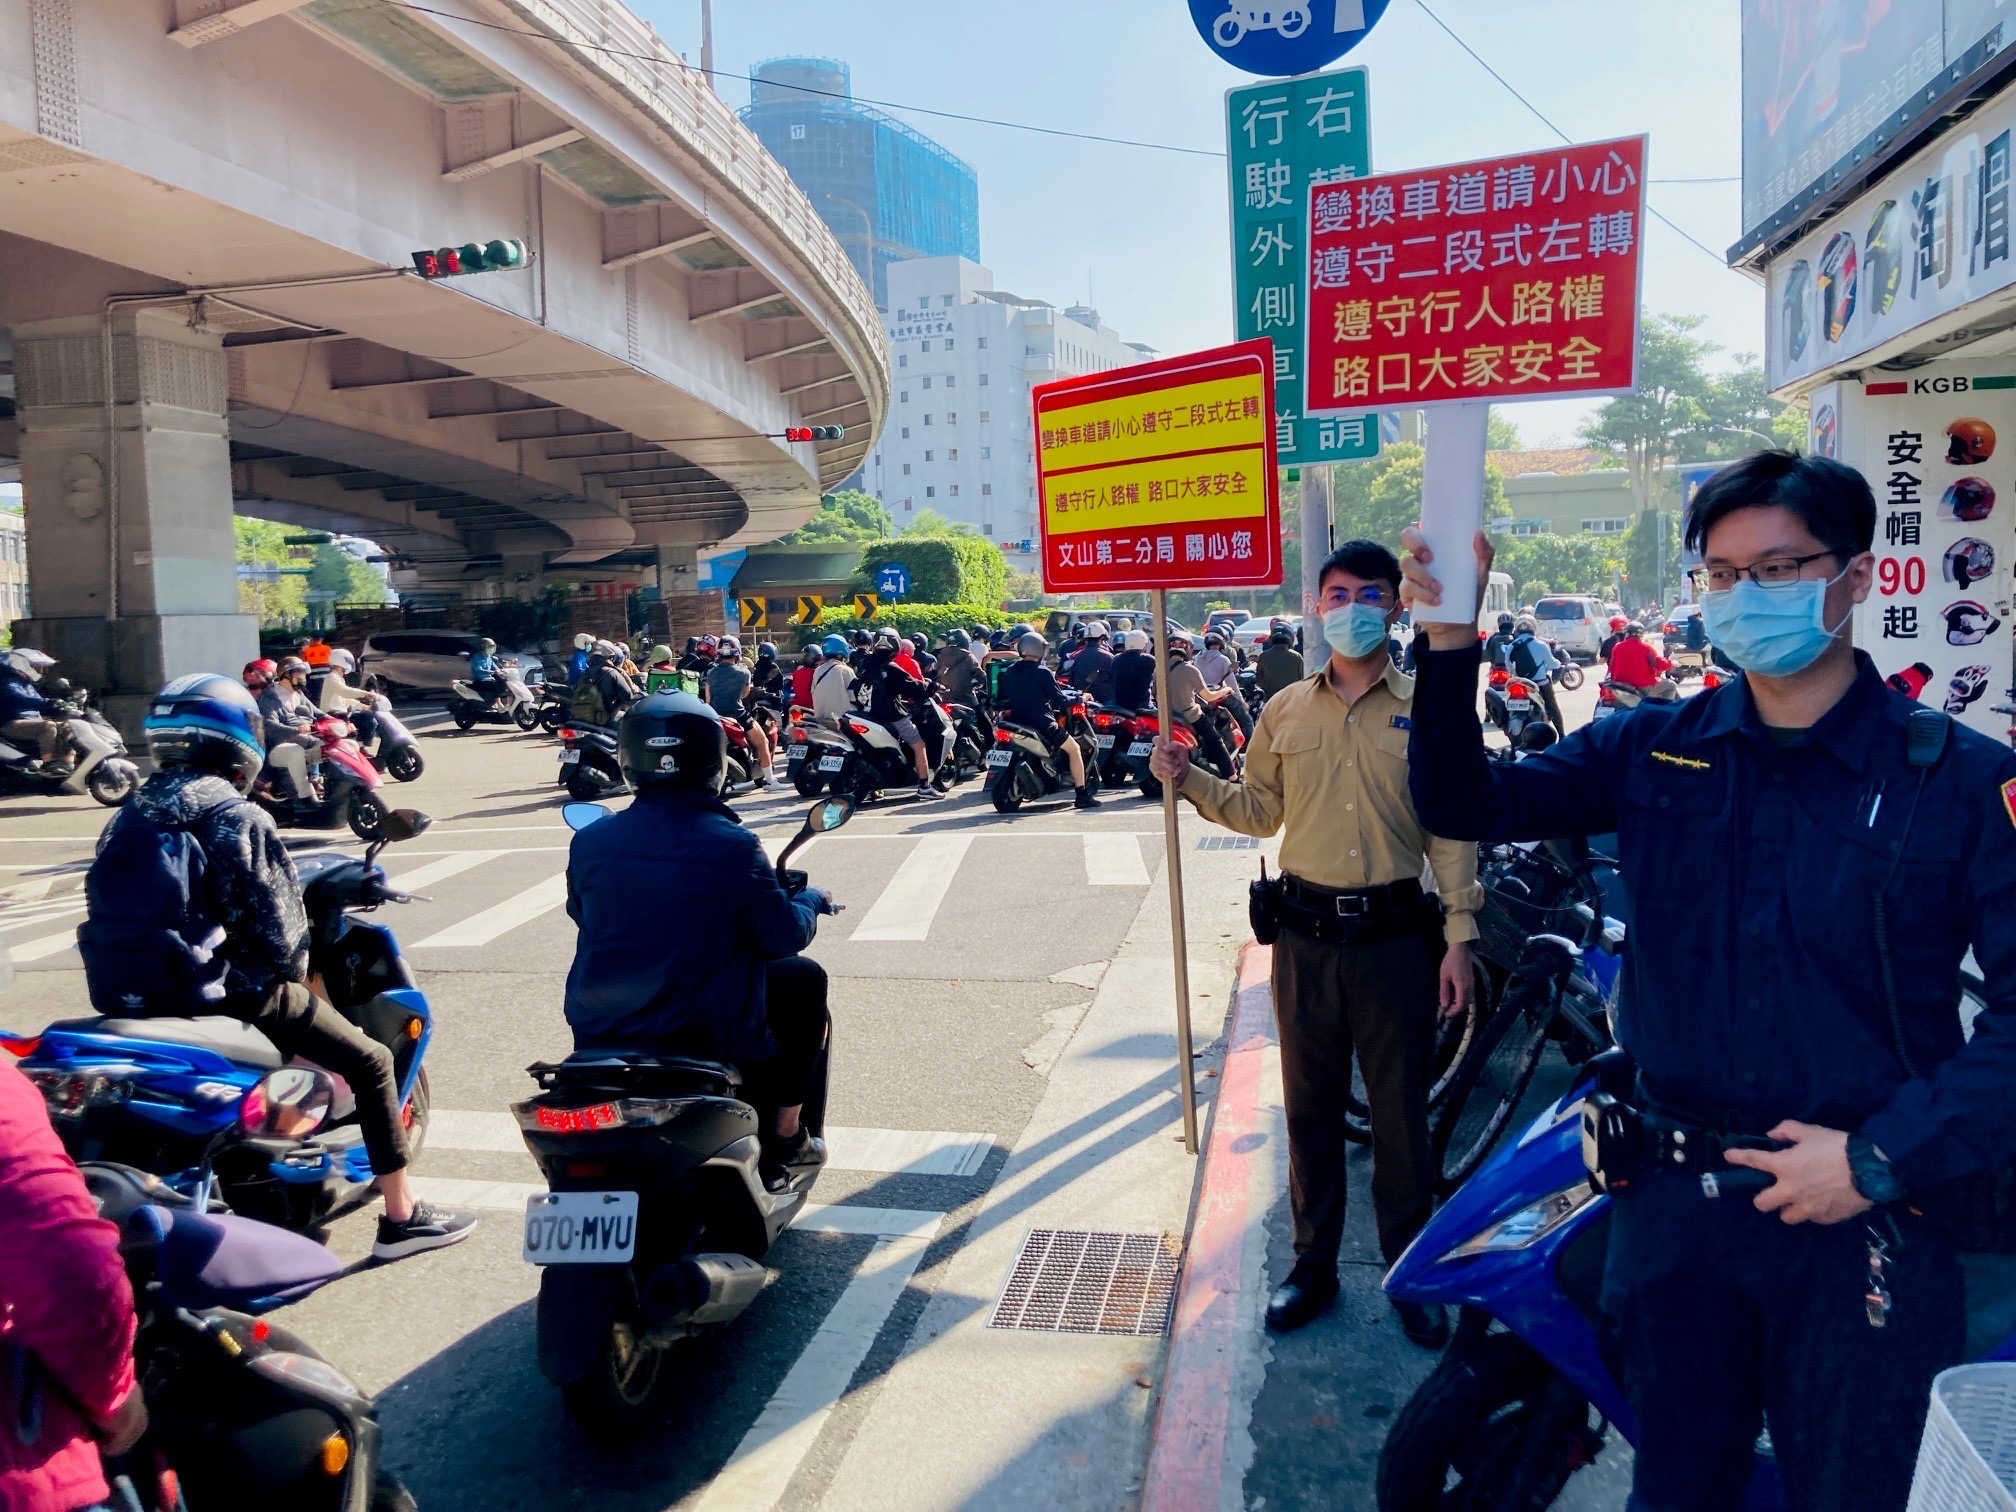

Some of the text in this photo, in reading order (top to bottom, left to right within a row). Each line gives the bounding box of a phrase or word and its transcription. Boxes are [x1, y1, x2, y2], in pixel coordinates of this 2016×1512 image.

[793, 126, 803, 138] 17
[1314, 150, 1637, 235] 變換車道請小心
[1313, 209, 1634, 290] 遵守二段式左轉
[1333, 275, 1606, 343] 遵守行人路權
[1332, 336, 1603, 398] 路口大家安全
[1914, 376, 1969, 394] KGB
[1055, 471, 1248, 513] 遵守行人路權 路口大家安全
[1058, 530, 1253, 568] 文山第二分局 關心您
[526, 1215, 634, 1252] 070-MVU
